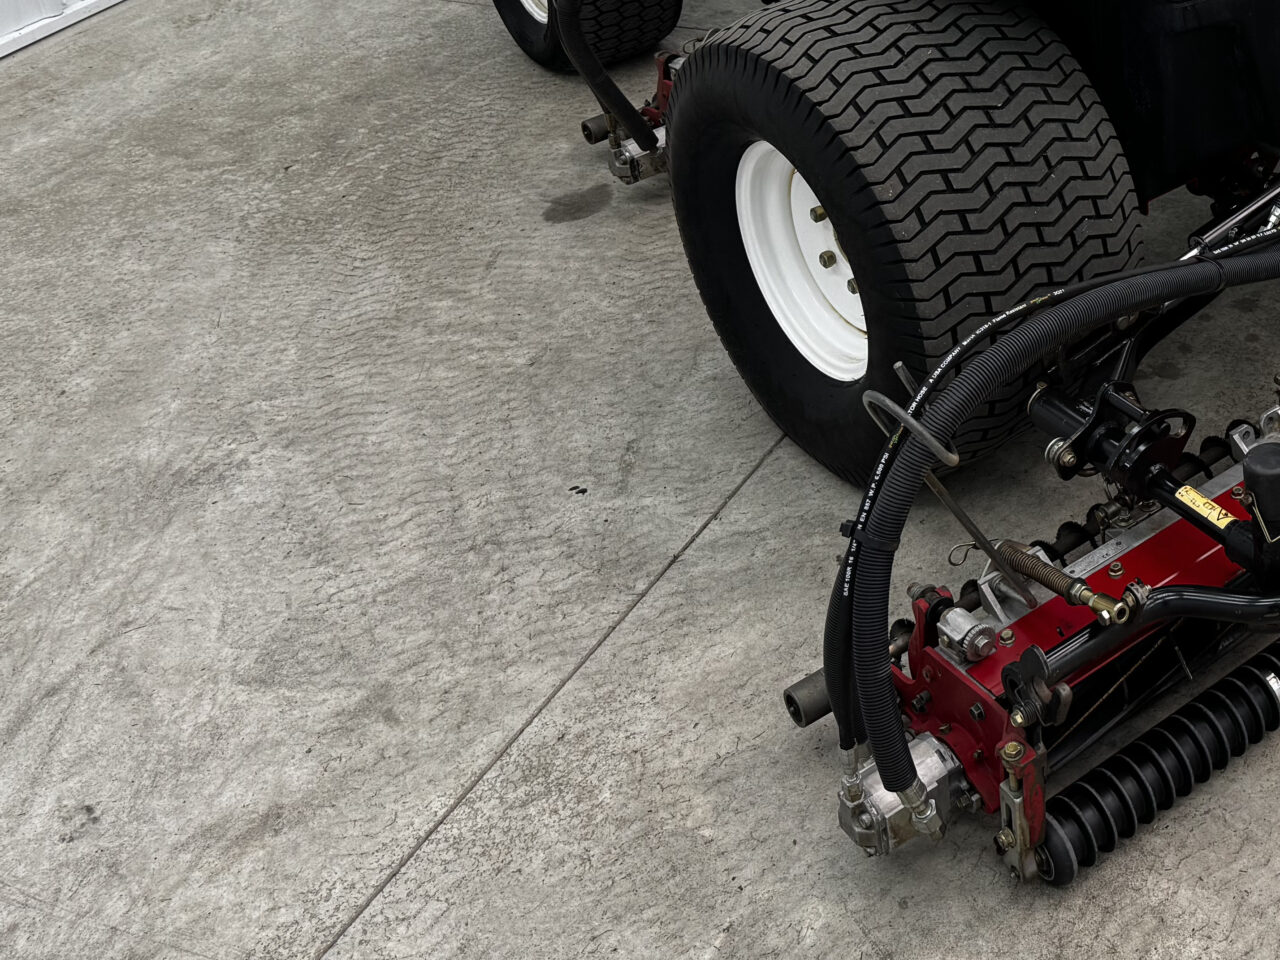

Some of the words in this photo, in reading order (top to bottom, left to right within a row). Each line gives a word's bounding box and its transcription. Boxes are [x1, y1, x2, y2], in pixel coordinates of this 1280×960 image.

[915, 386, 928, 402] HOSE
[931, 367, 942, 379] USA
[940, 346, 961, 368] COMPANY
